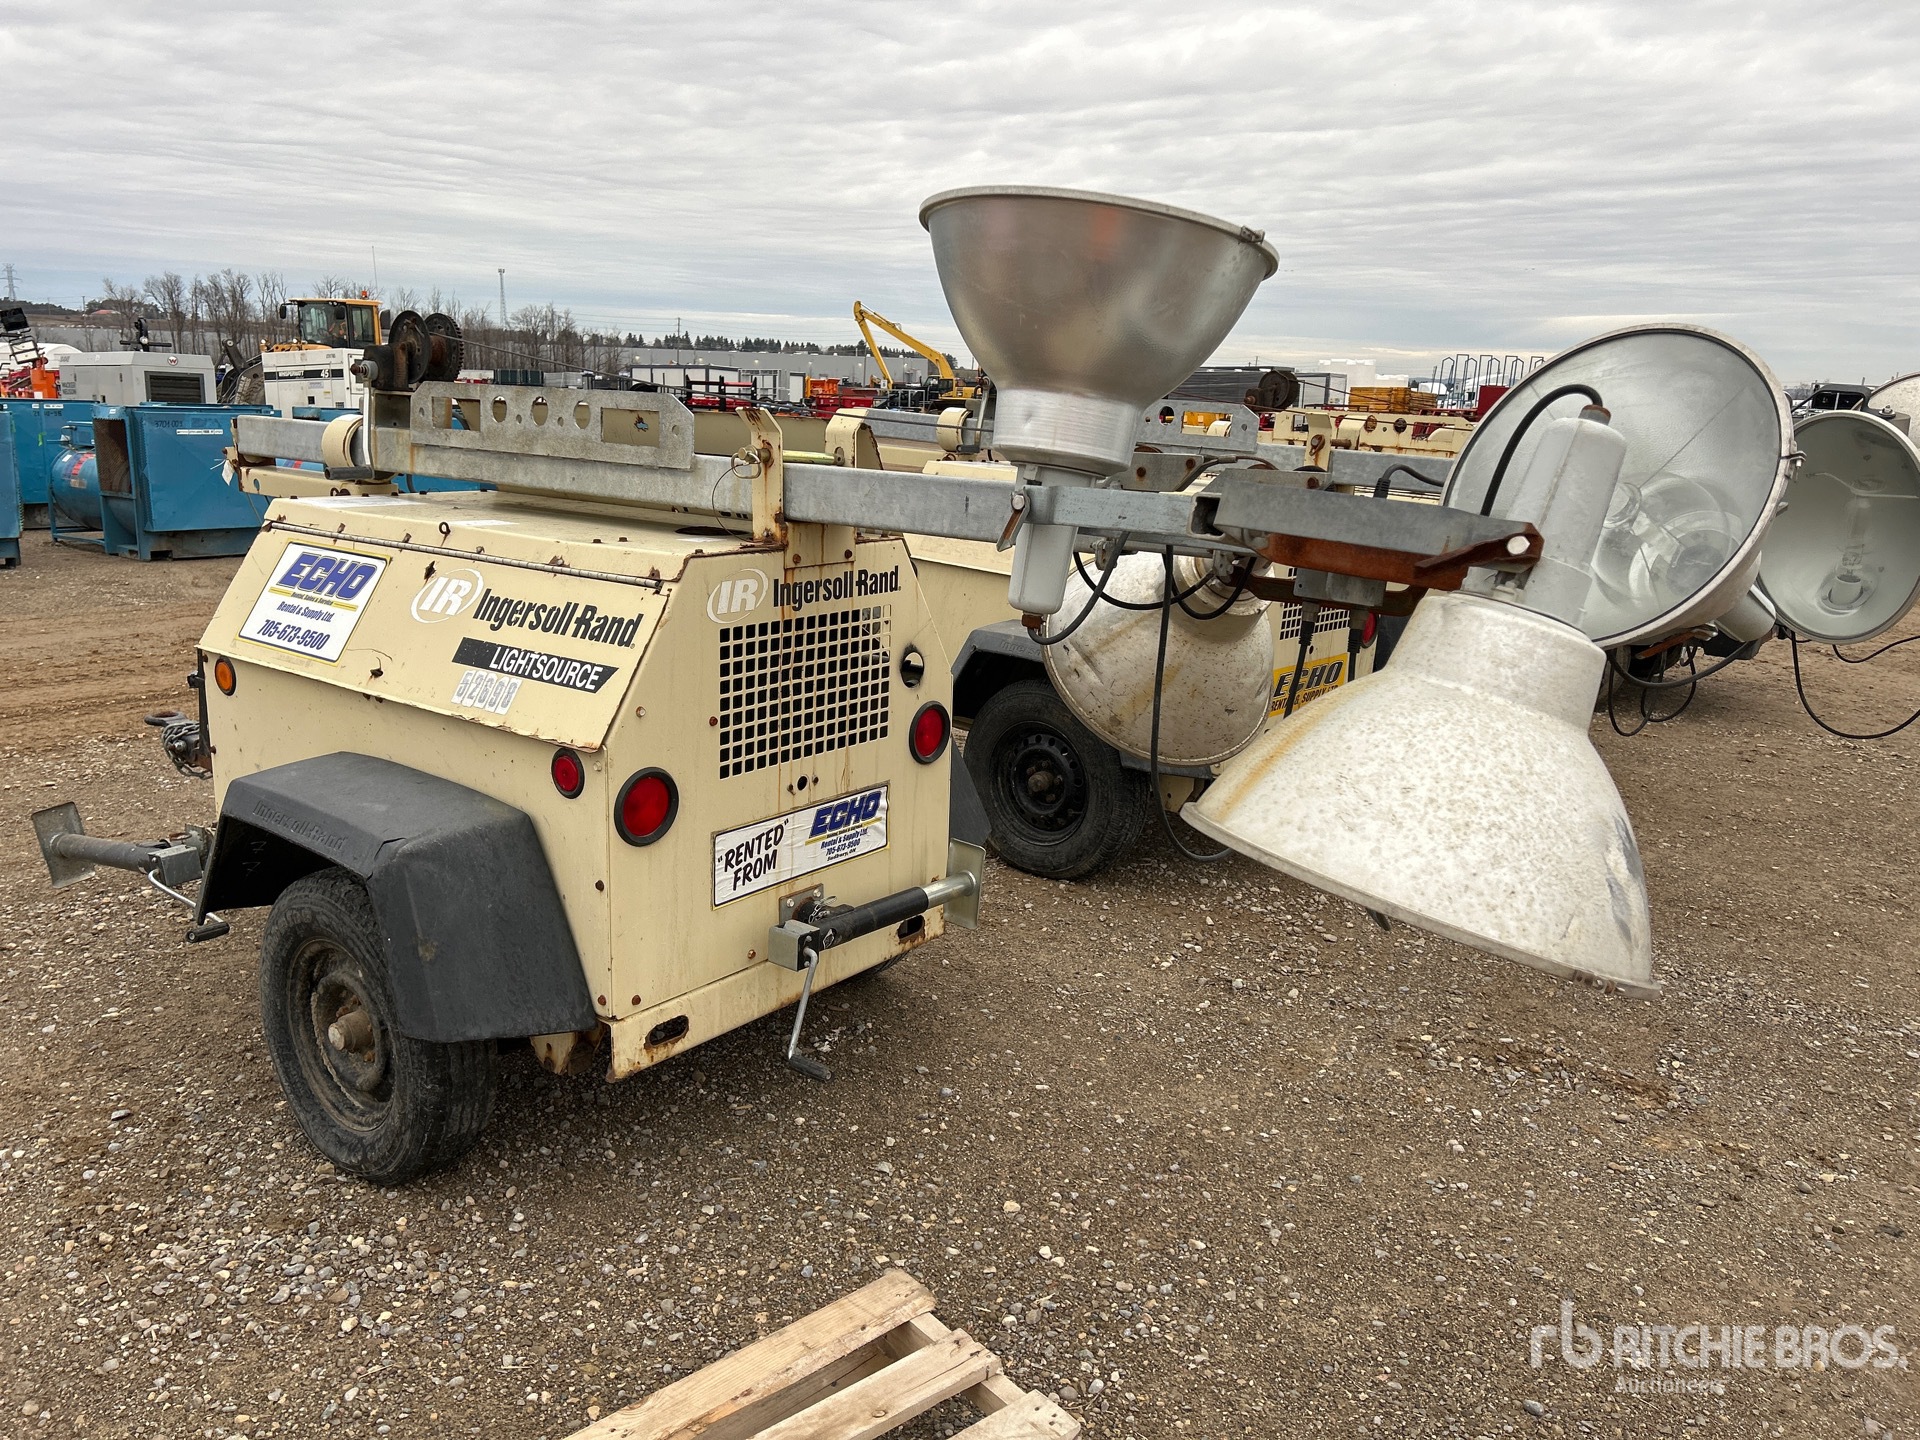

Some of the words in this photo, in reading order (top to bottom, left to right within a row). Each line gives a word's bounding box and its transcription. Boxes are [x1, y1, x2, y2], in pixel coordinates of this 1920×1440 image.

[320, 369, 329, 378] 45
[275, 552, 377, 600] ECHO
[277, 601, 298, 613] Rental
[301, 606, 323, 620] Supply
[418, 576, 473, 615] IR
[717, 578, 759, 615] IR
[257, 619, 330, 650] 705-673-9500
[489, 647, 603, 690] LIGHTSOURCE
[809, 791, 882, 838] ECHO
[821, 837, 838, 849] Rental
[842, 830, 859, 842] Supply
[826, 838, 860, 856] 705-673-9500
[733, 849, 778, 891] FROM
